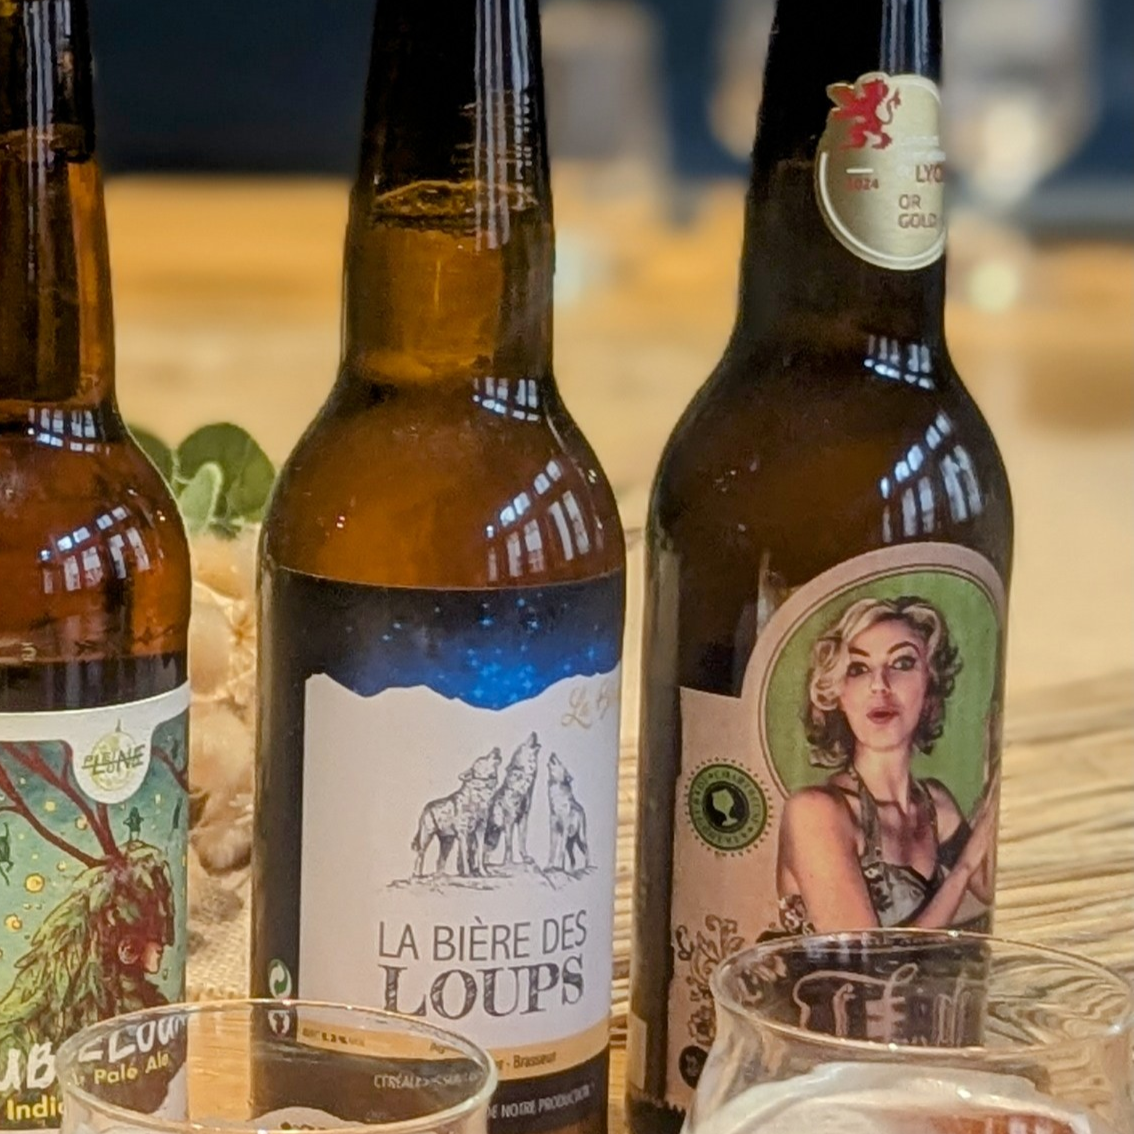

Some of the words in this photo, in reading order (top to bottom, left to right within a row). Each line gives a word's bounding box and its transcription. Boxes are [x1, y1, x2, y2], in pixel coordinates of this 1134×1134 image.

[899, 194, 921, 210] OR
[898, 214, 937, 229] GOLD
[378, 921, 419, 960] LA
[433, 915, 531, 961] BIÈRE
[542, 909, 587, 955] DES
[378, 953, 585, 1020] LOUPS
[94, 1063, 139, 1085] Pale
[145, 1051, 170, 1074] Ale
